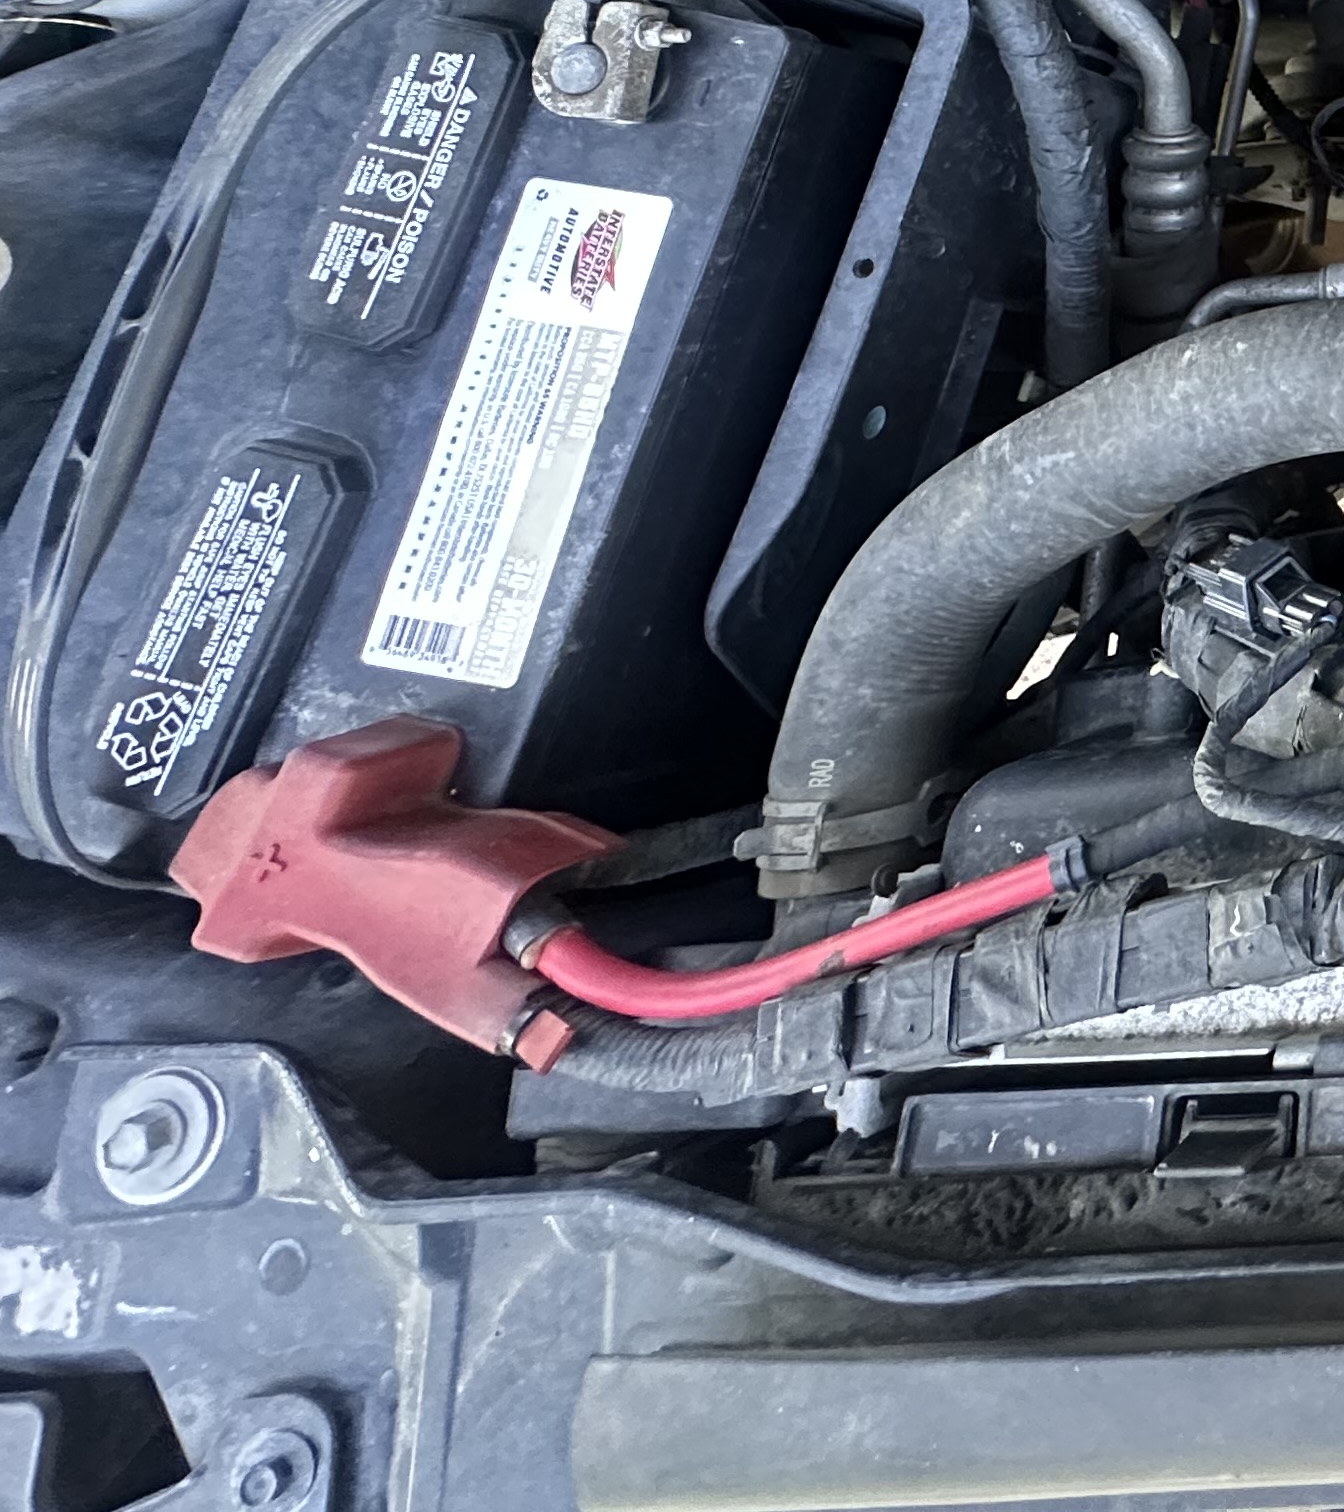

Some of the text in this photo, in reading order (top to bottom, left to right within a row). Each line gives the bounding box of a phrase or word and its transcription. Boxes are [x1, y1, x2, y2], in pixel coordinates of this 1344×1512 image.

[422, 106, 471, 190] DANGER
[382, 206, 430, 285] POISON
[538, 206, 580, 295] AUTOMOTIVE
[569, 210, 609, 297] BATTERIES
[579, 209, 624, 306] INTERSTATE
[190, 517, 249, 630] MEDICAL HELP FAST
[237, 520, 260, 552] WITH
[196, 521, 272, 669] FLUSH EYES IMMEDIATELY
[807, 758, 835, 790] RAD
